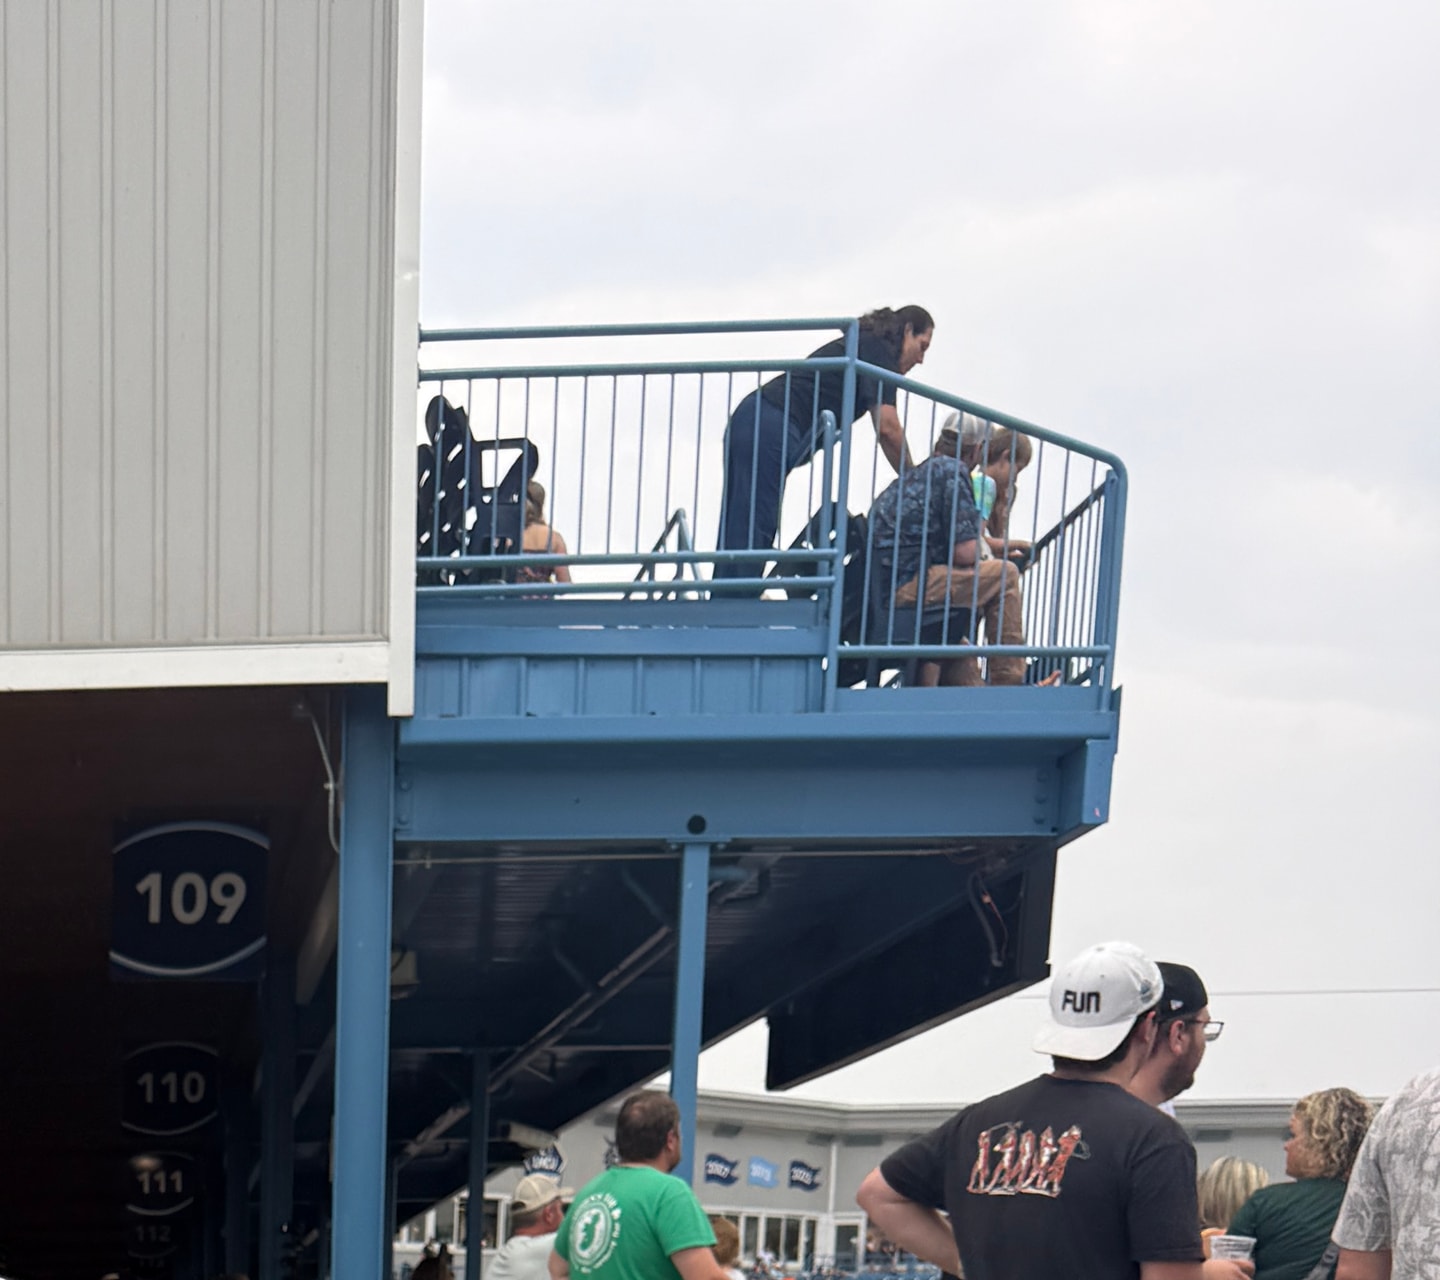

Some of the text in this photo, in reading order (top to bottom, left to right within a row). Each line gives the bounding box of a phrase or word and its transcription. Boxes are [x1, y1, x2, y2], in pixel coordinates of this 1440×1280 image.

[135, 871, 247, 925] 109
[137, 1071, 205, 1103] 110
[137, 1169, 183, 1195] 111
[135, 1224, 172, 1243] 112
